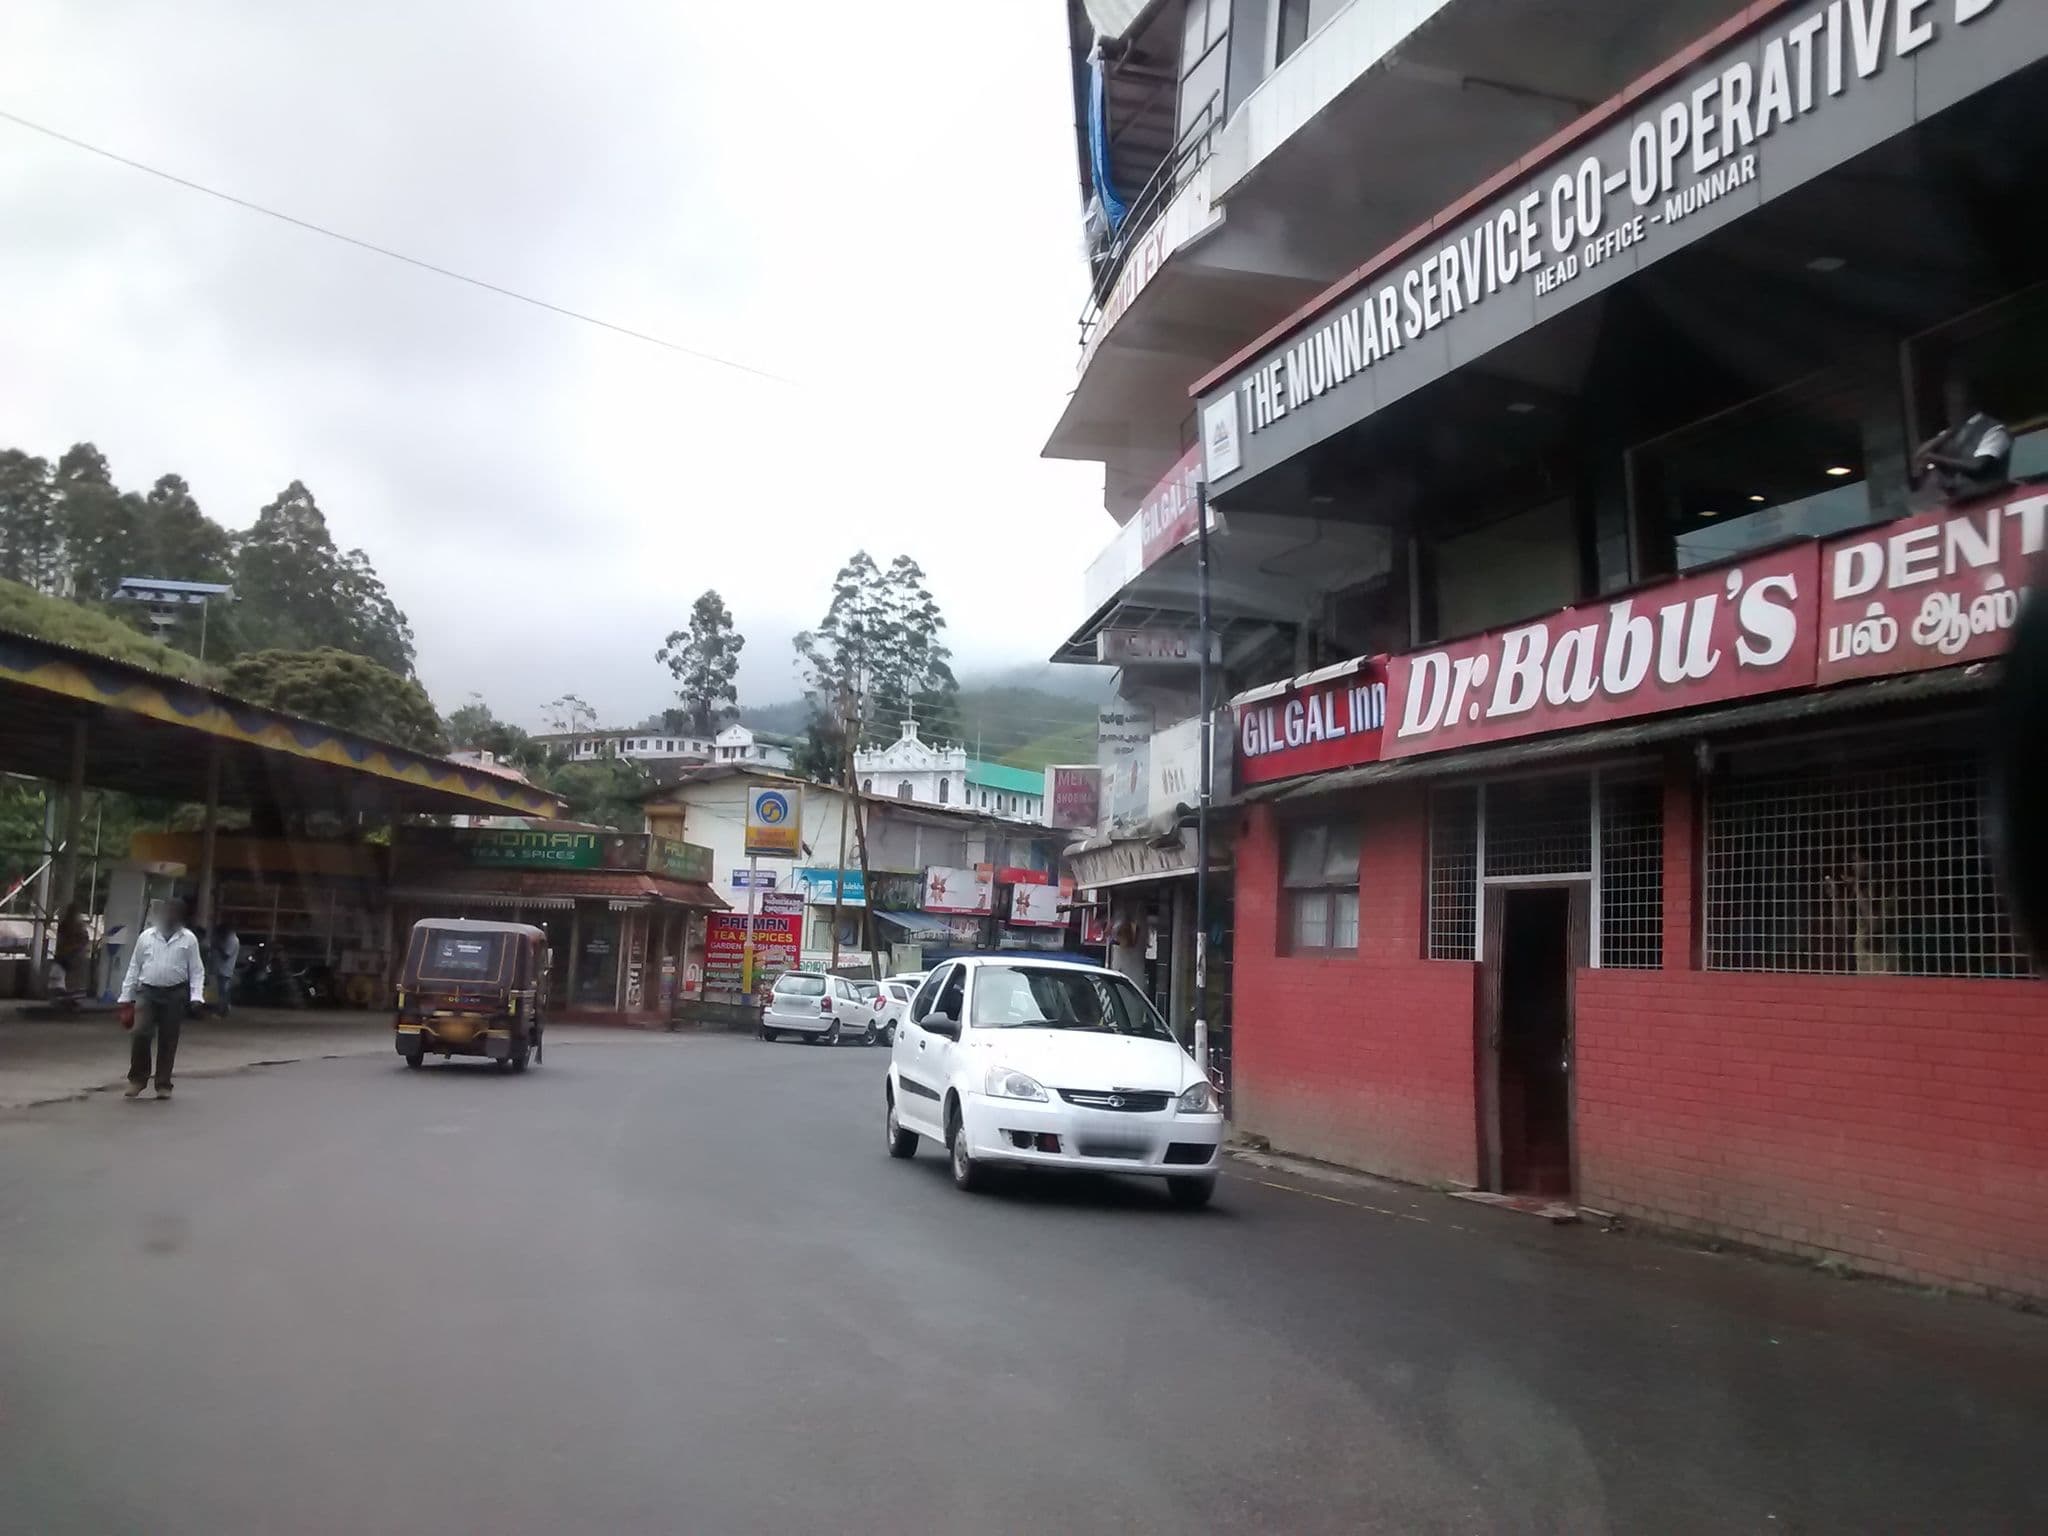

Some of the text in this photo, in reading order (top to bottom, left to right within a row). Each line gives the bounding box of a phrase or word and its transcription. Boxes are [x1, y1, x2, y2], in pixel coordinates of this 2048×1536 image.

[1535, 254, 1579, 297] HEAD
[1584, 214, 1646, 269] OFFICE
[1665, 153, 1757, 226] MUNNAR
[1242, 358, 1287, 434] THE
[1286, 285, 1402, 410] MUNNAR
[1403, 189, 1543, 340] SERVICE
[1242, 691, 1346, 757] GILGAL
[522, 849, 576, 860] SPICES
[713, 930, 736, 941] TEA
[751, 932, 793, 943] SPICES
